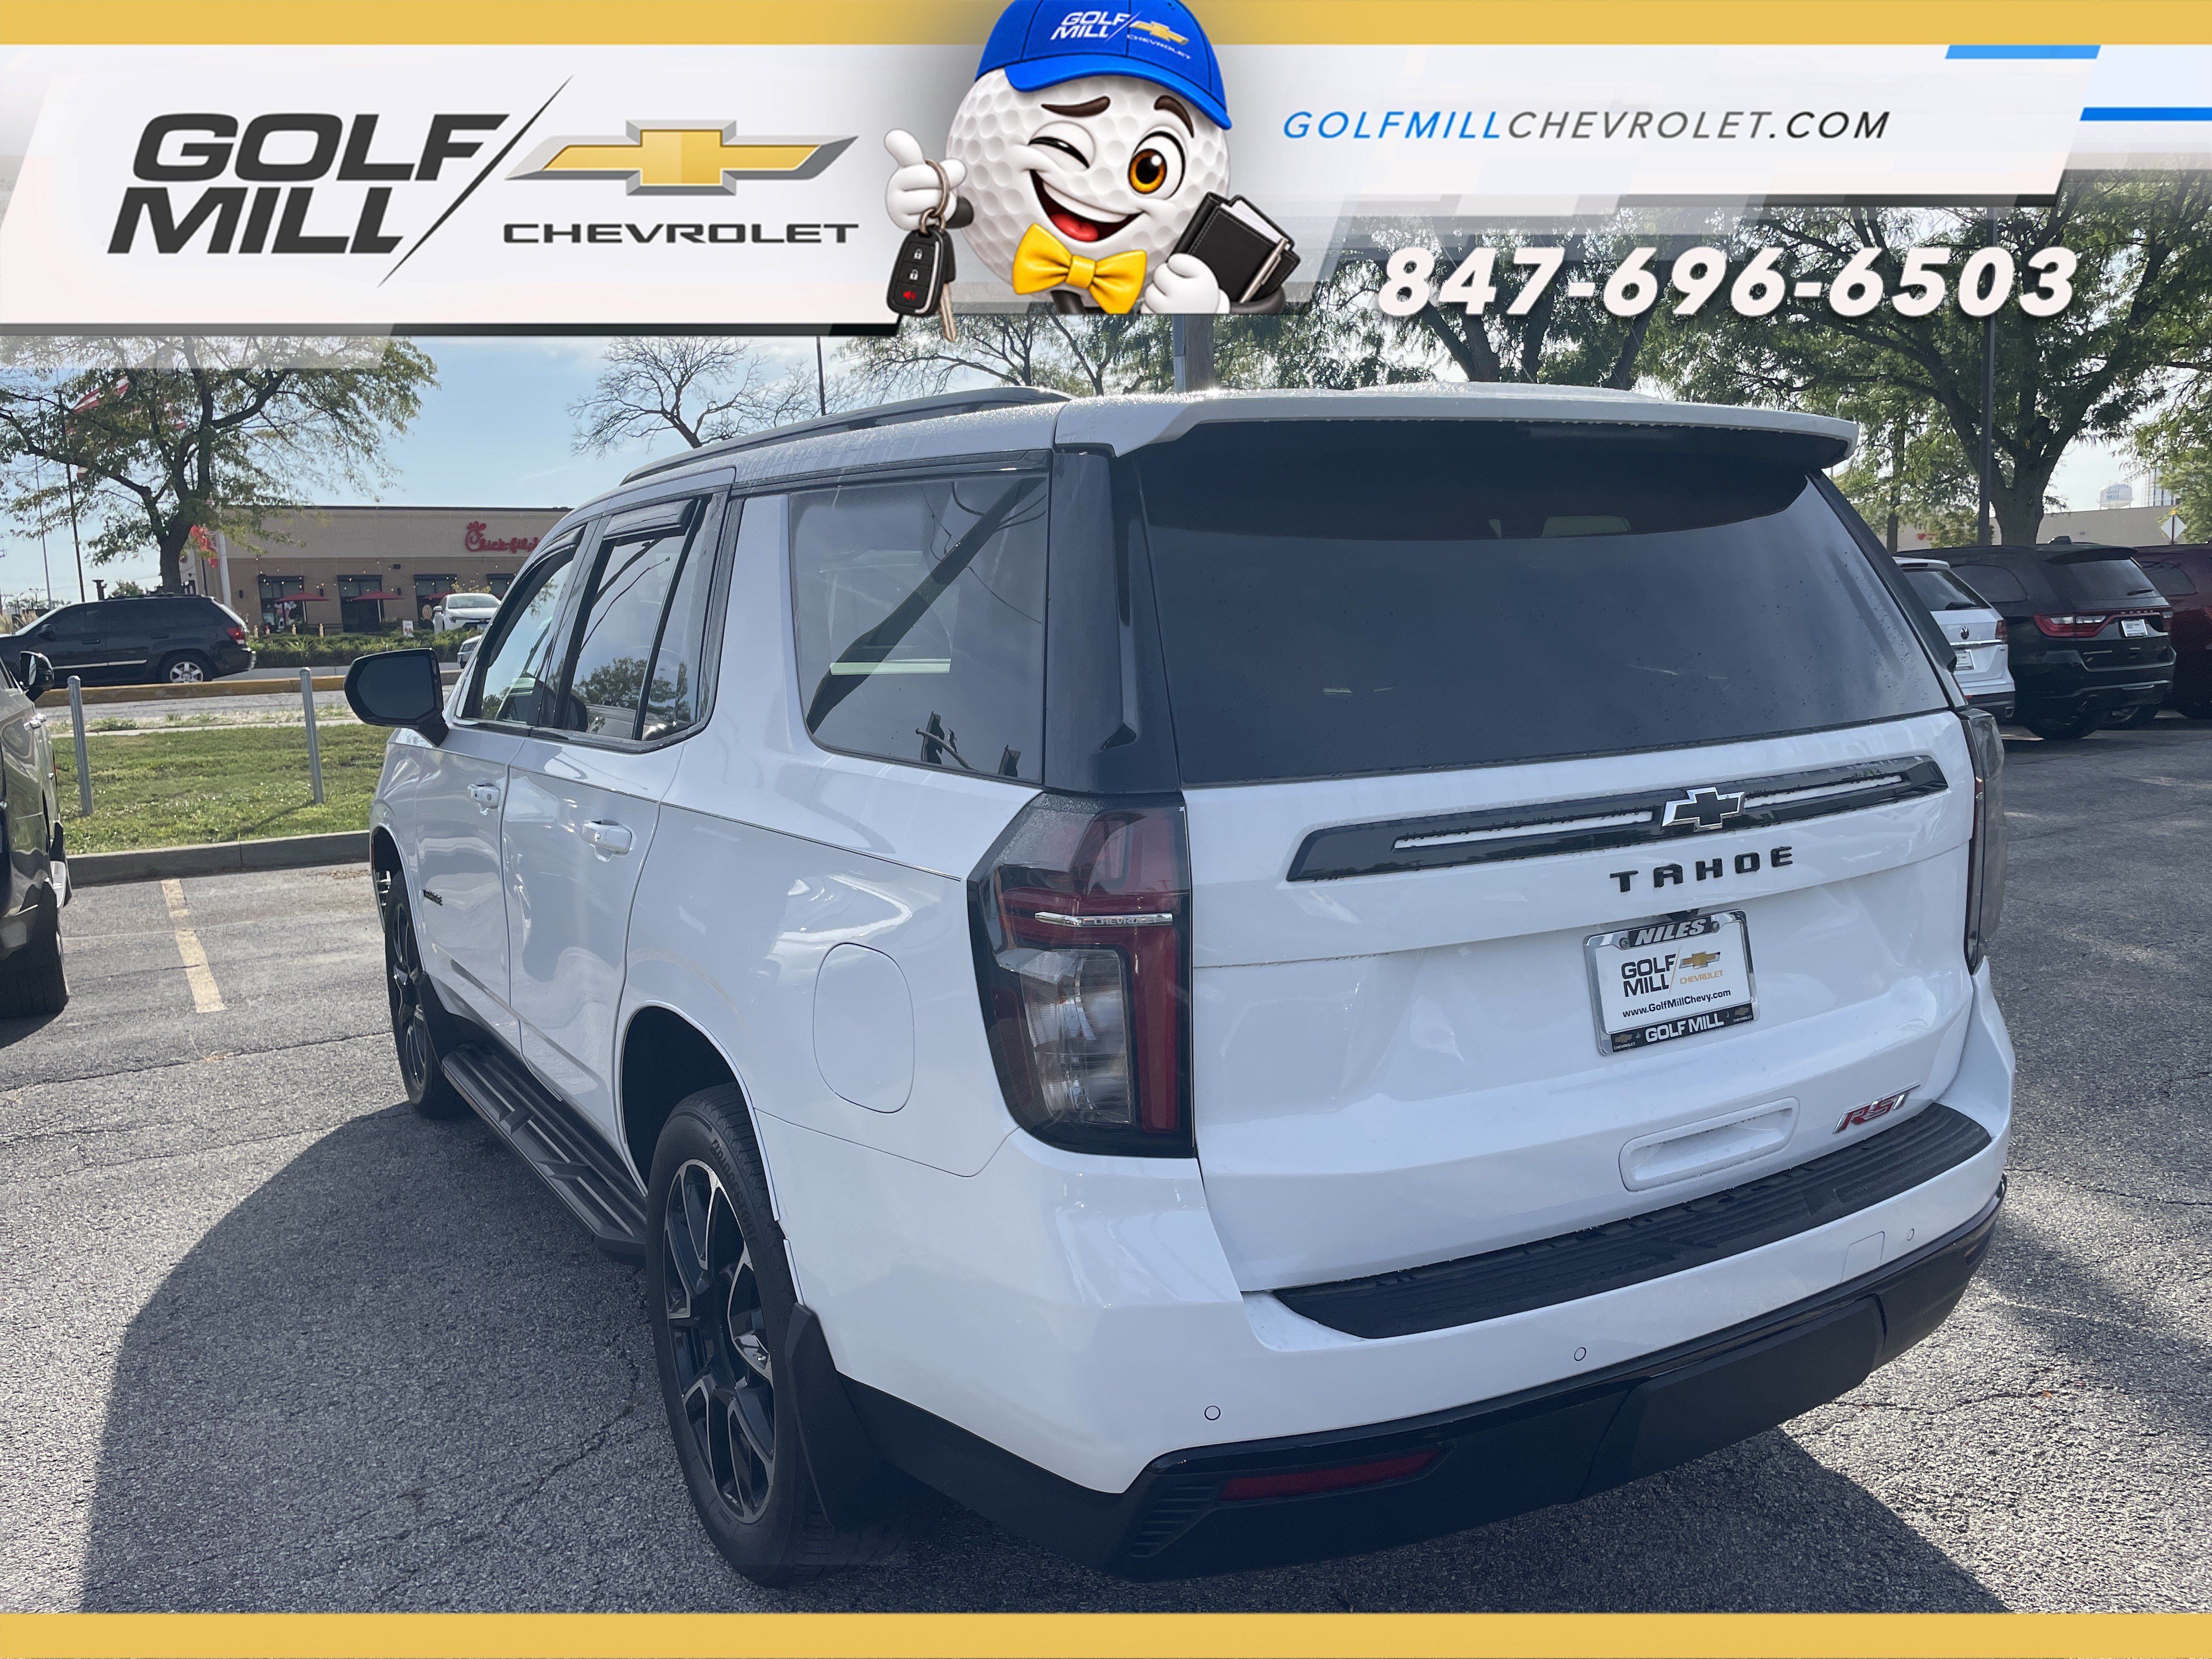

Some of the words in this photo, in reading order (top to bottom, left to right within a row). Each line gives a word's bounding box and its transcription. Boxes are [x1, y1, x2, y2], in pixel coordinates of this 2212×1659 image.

[1610, 846, 1793, 893] TAHOE
[1634, 918, 1706, 946] NILES
[1621, 953, 1677, 980] GOLF
[1679, 970, 1724, 985] CHEVROLET
[1623, 974, 1670, 997] MILL
[1622, 990, 1731, 1018] www.GolfMillChevy.com
[1645, 1020, 1688, 1042] GOLF
[1688, 1013, 1724, 1032] MILL
[1832, 1082, 1920, 1134] RST
